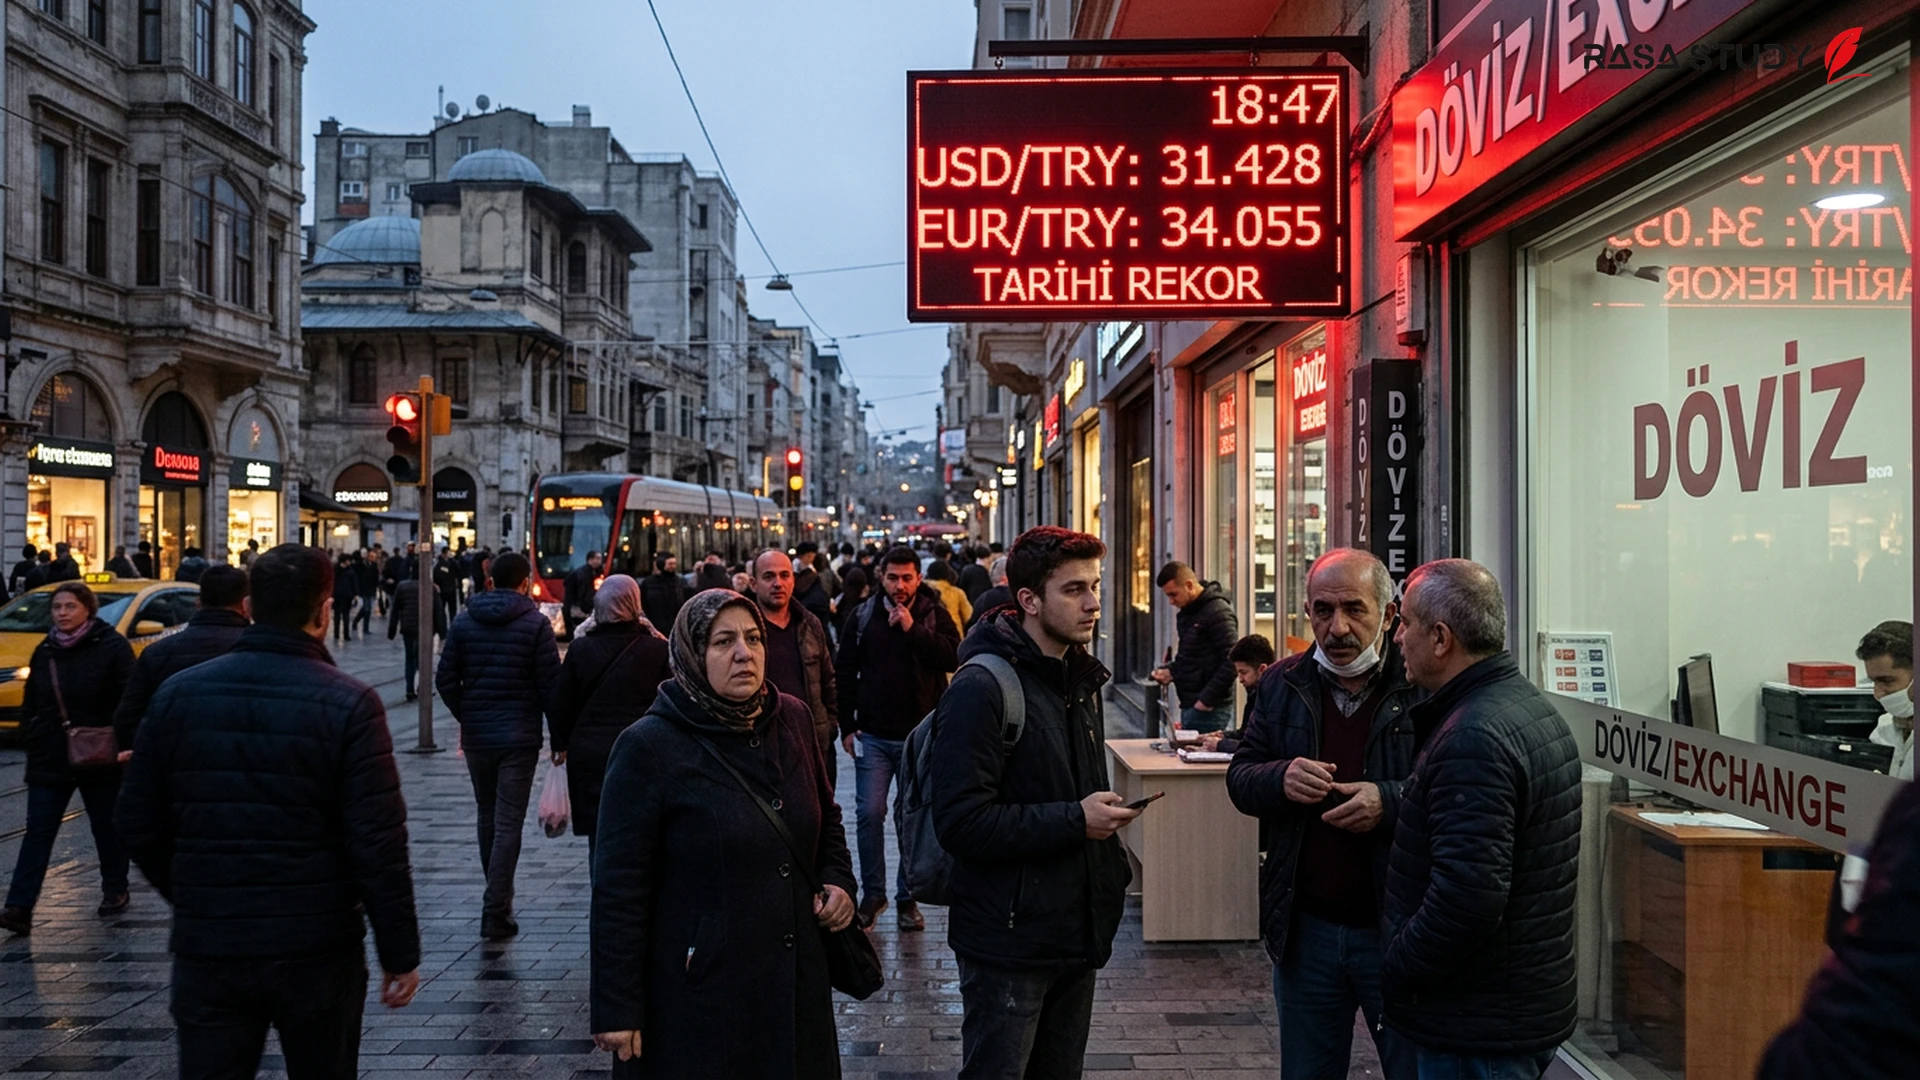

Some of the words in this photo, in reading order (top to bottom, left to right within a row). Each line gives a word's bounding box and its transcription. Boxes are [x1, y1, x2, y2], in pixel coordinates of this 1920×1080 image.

[1212, 84, 1339, 125] 18:47
[918, 145, 1138, 195] USD/TRY:
[1162, 143, 1321, 185] 31.428
[918, 206, 1138, 256] EUR/TRY:
[1162, 206, 1321, 247] 34.055
[973, 260, 1118, 301] TARİHİ
[1128, 266, 1263, 301] REKOR
[1634, 340, 1867, 500] DÖVİZ
[1595, 715, 1847, 837] DÖVİZ/EXCHANGE
